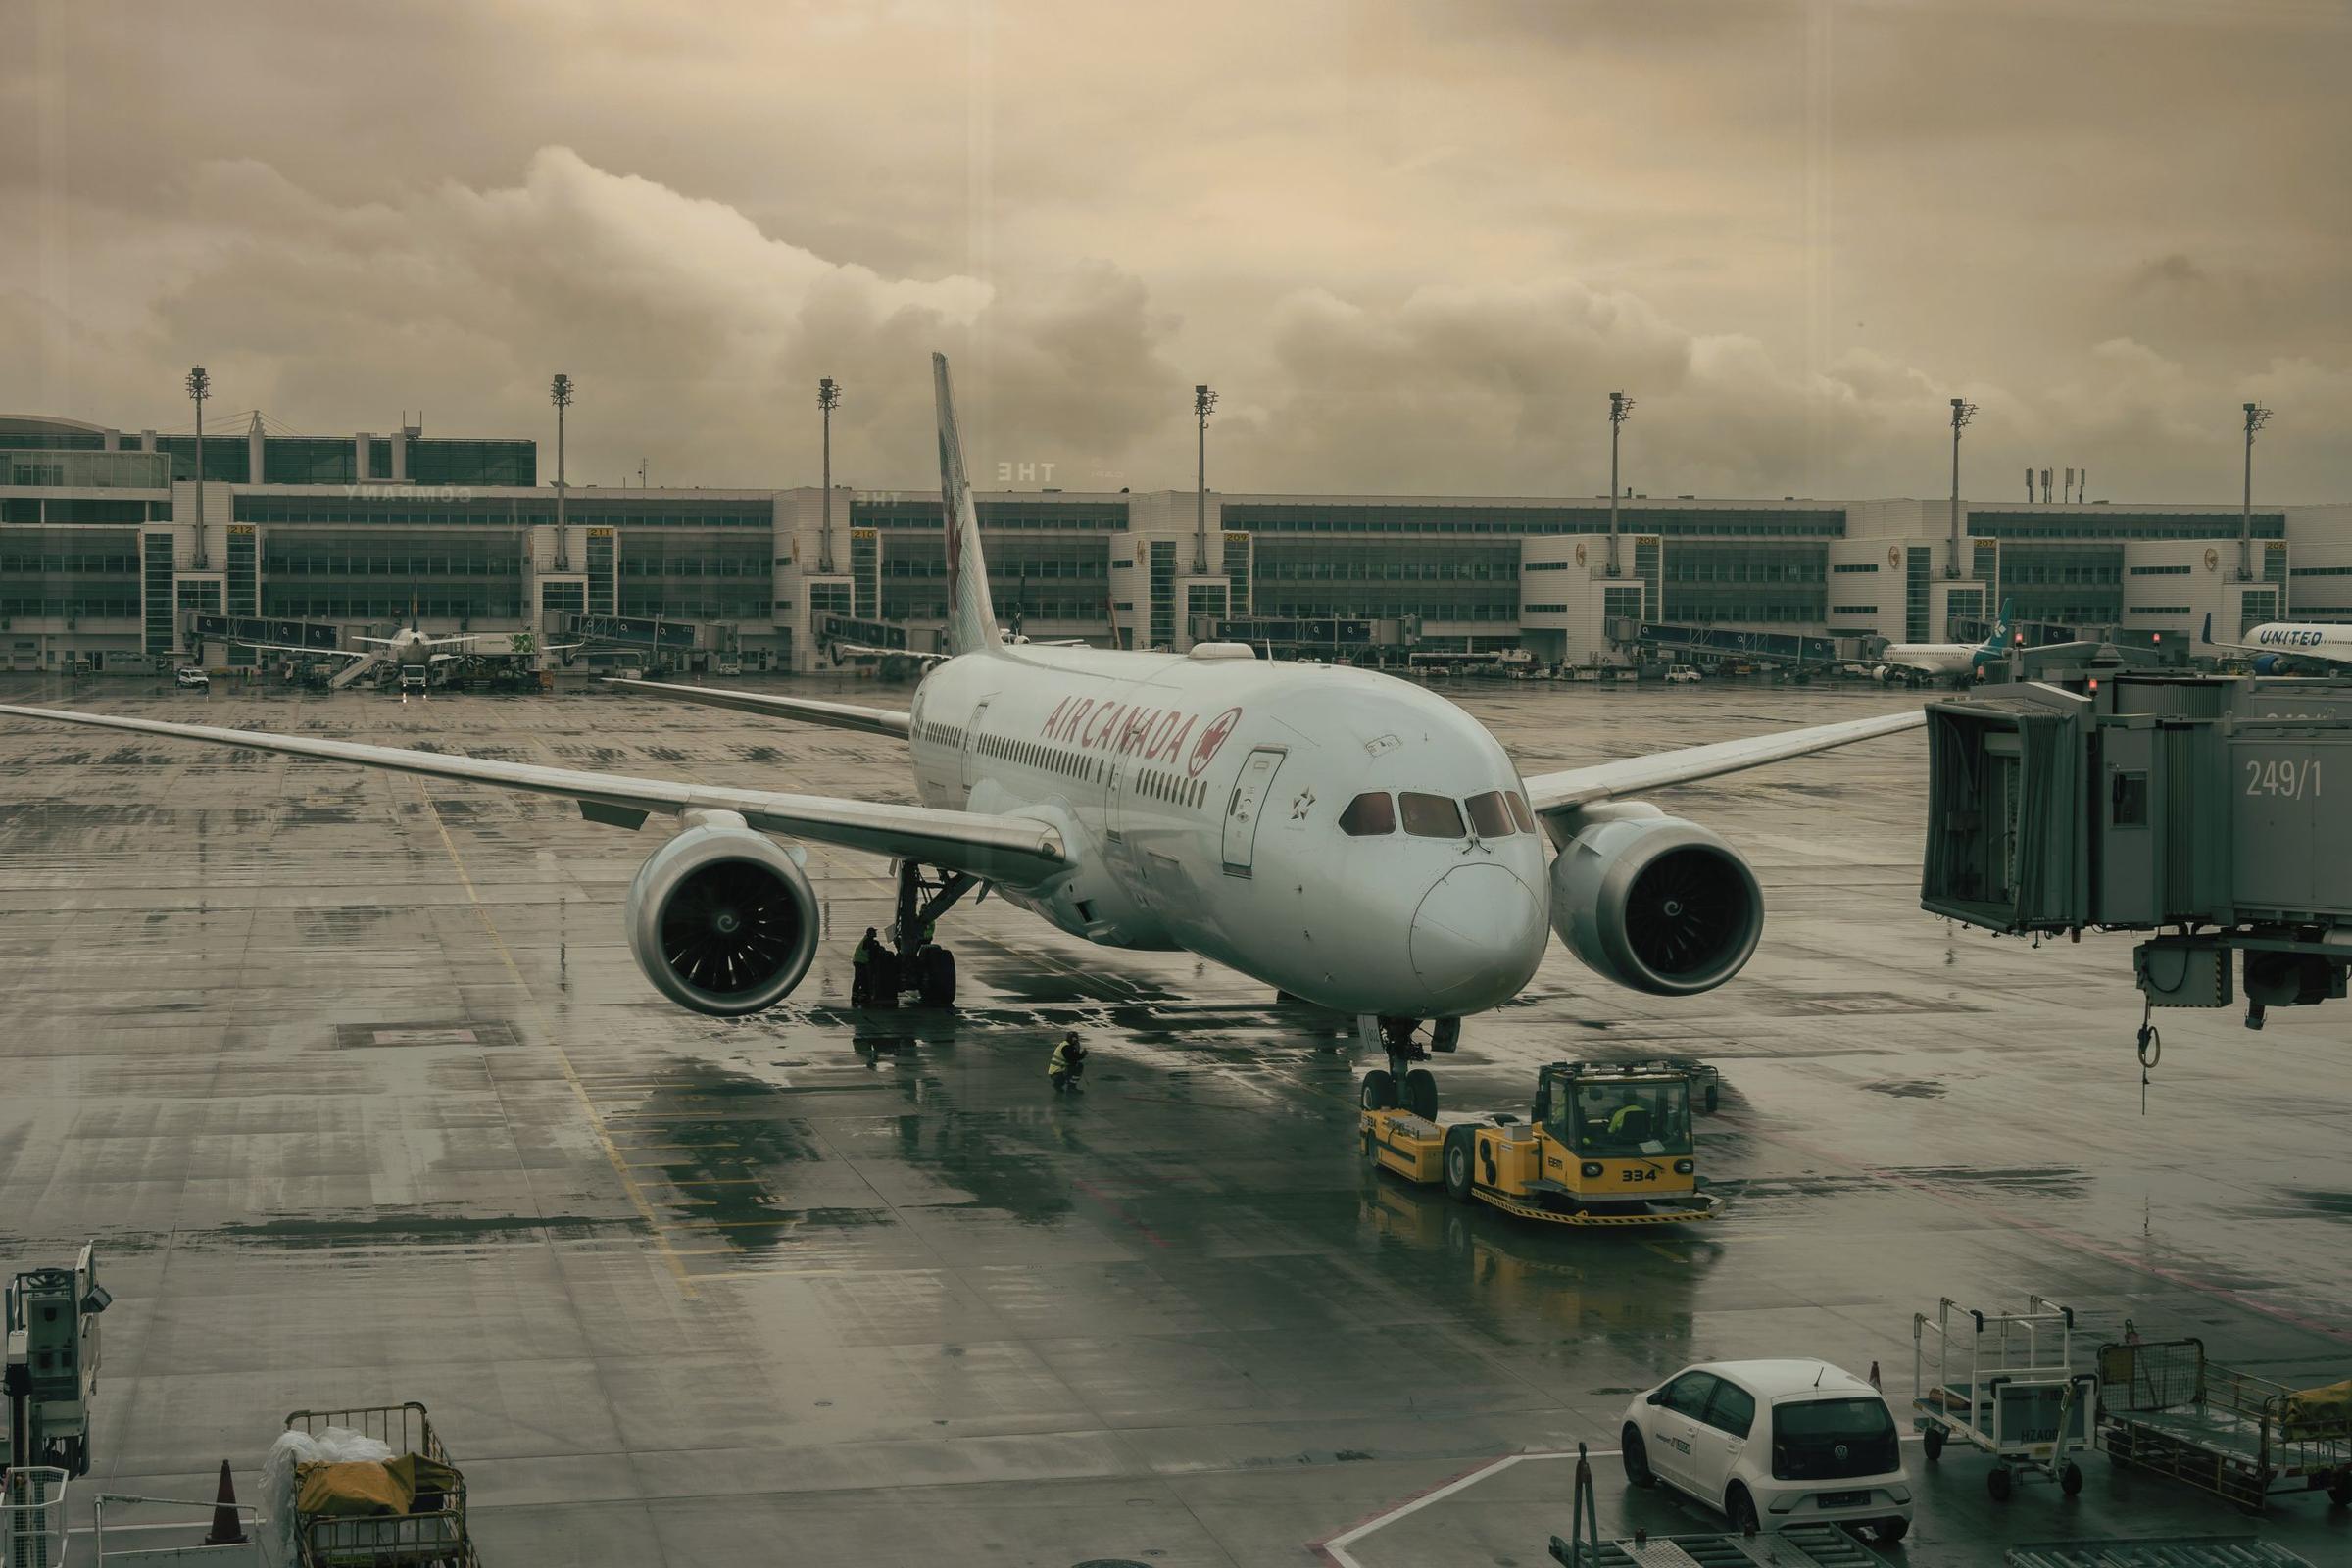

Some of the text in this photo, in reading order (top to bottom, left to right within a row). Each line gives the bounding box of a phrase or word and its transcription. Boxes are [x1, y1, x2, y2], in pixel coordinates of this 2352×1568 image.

[2260, 630, 2323, 646] UNITED
[2246, 760, 2322, 800] 249/1
[1622, 1169, 1657, 1182] 334
